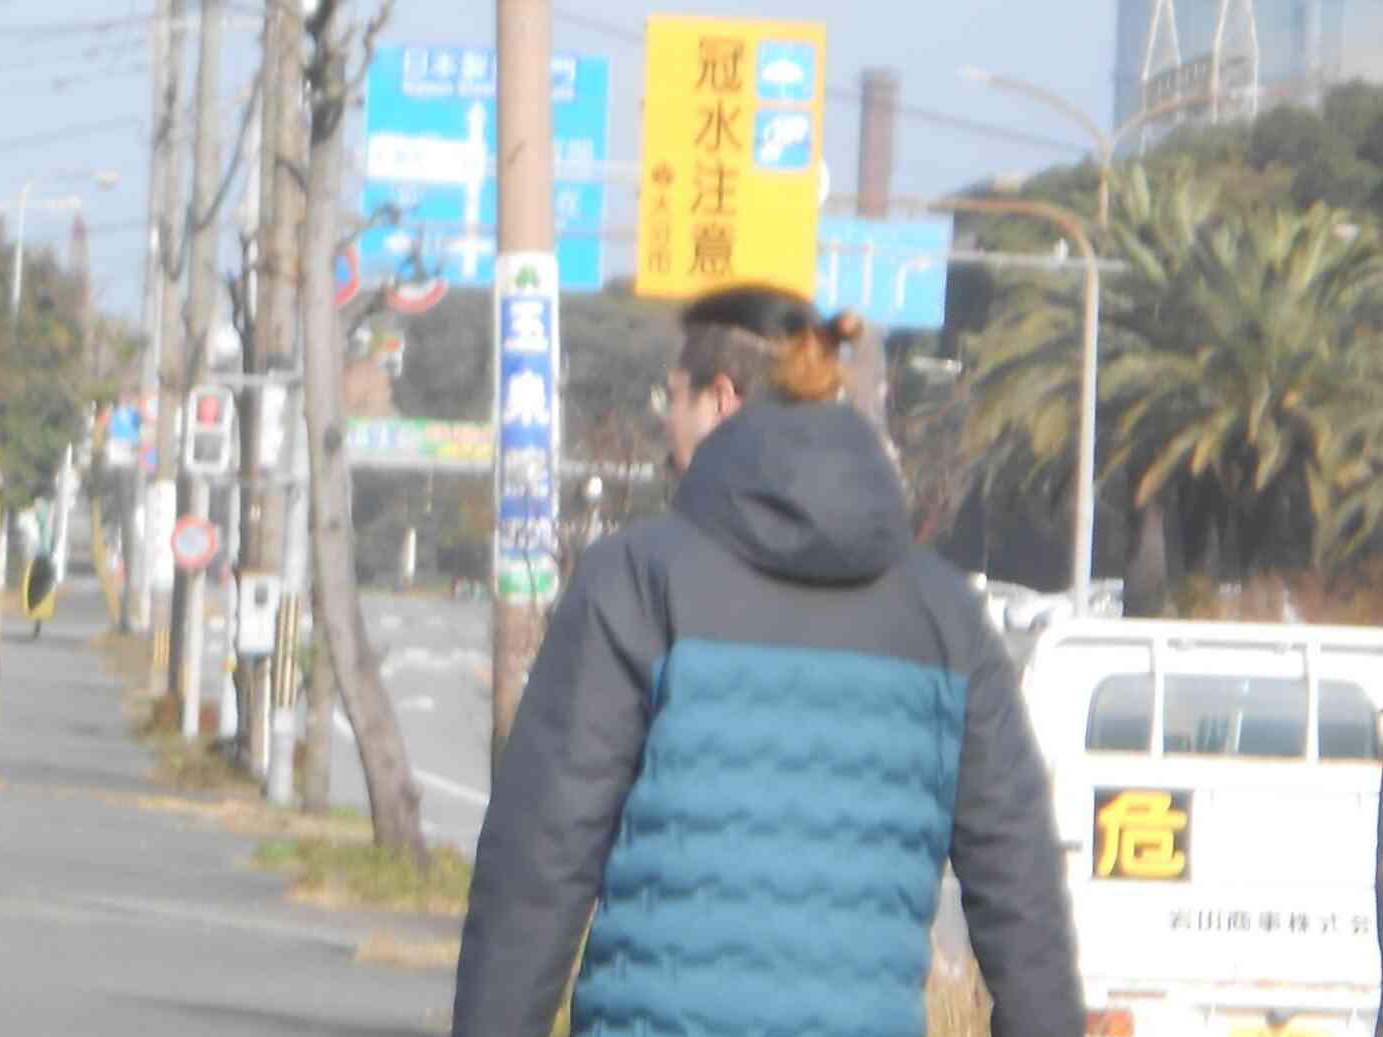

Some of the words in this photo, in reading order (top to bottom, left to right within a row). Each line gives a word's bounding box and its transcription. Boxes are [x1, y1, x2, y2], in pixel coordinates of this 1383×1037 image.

[690, 34, 745, 277] 冠水注意
[1097, 788, 1188, 878] 危
